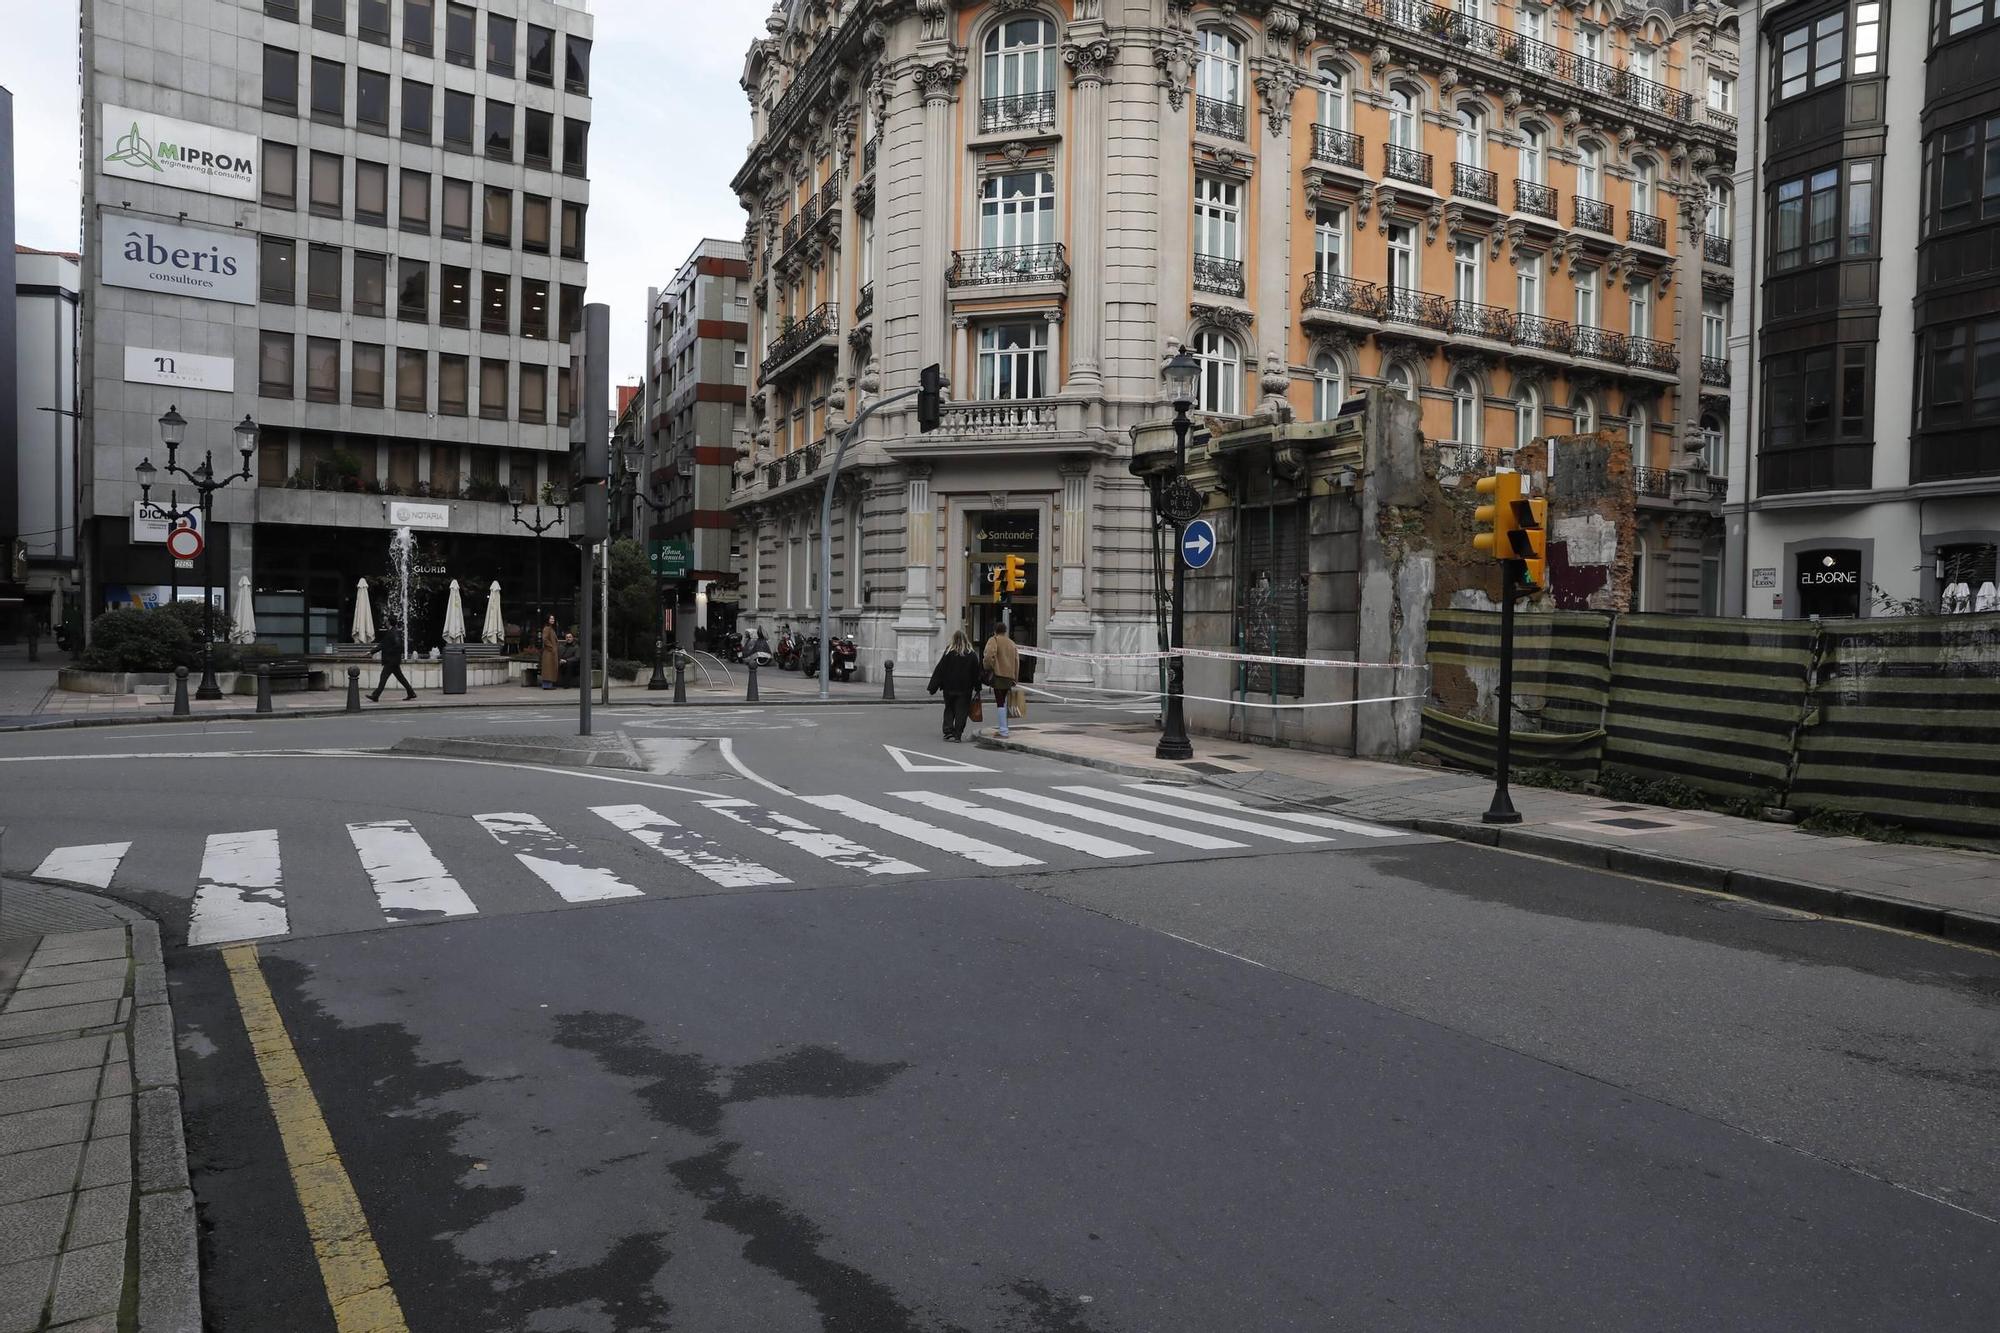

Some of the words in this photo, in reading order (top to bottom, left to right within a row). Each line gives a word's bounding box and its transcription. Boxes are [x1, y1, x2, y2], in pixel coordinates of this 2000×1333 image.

[158, 142, 252, 174] MIPROM
[124, 232, 237, 276] âberis
[149, 272, 214, 288] consultores
[988, 530, 1035, 540] Santander
[413, 565, 446, 573] GLORIA
[1802, 572, 1814, 584] EL
[1816, 571, 1857, 584] BORNE
